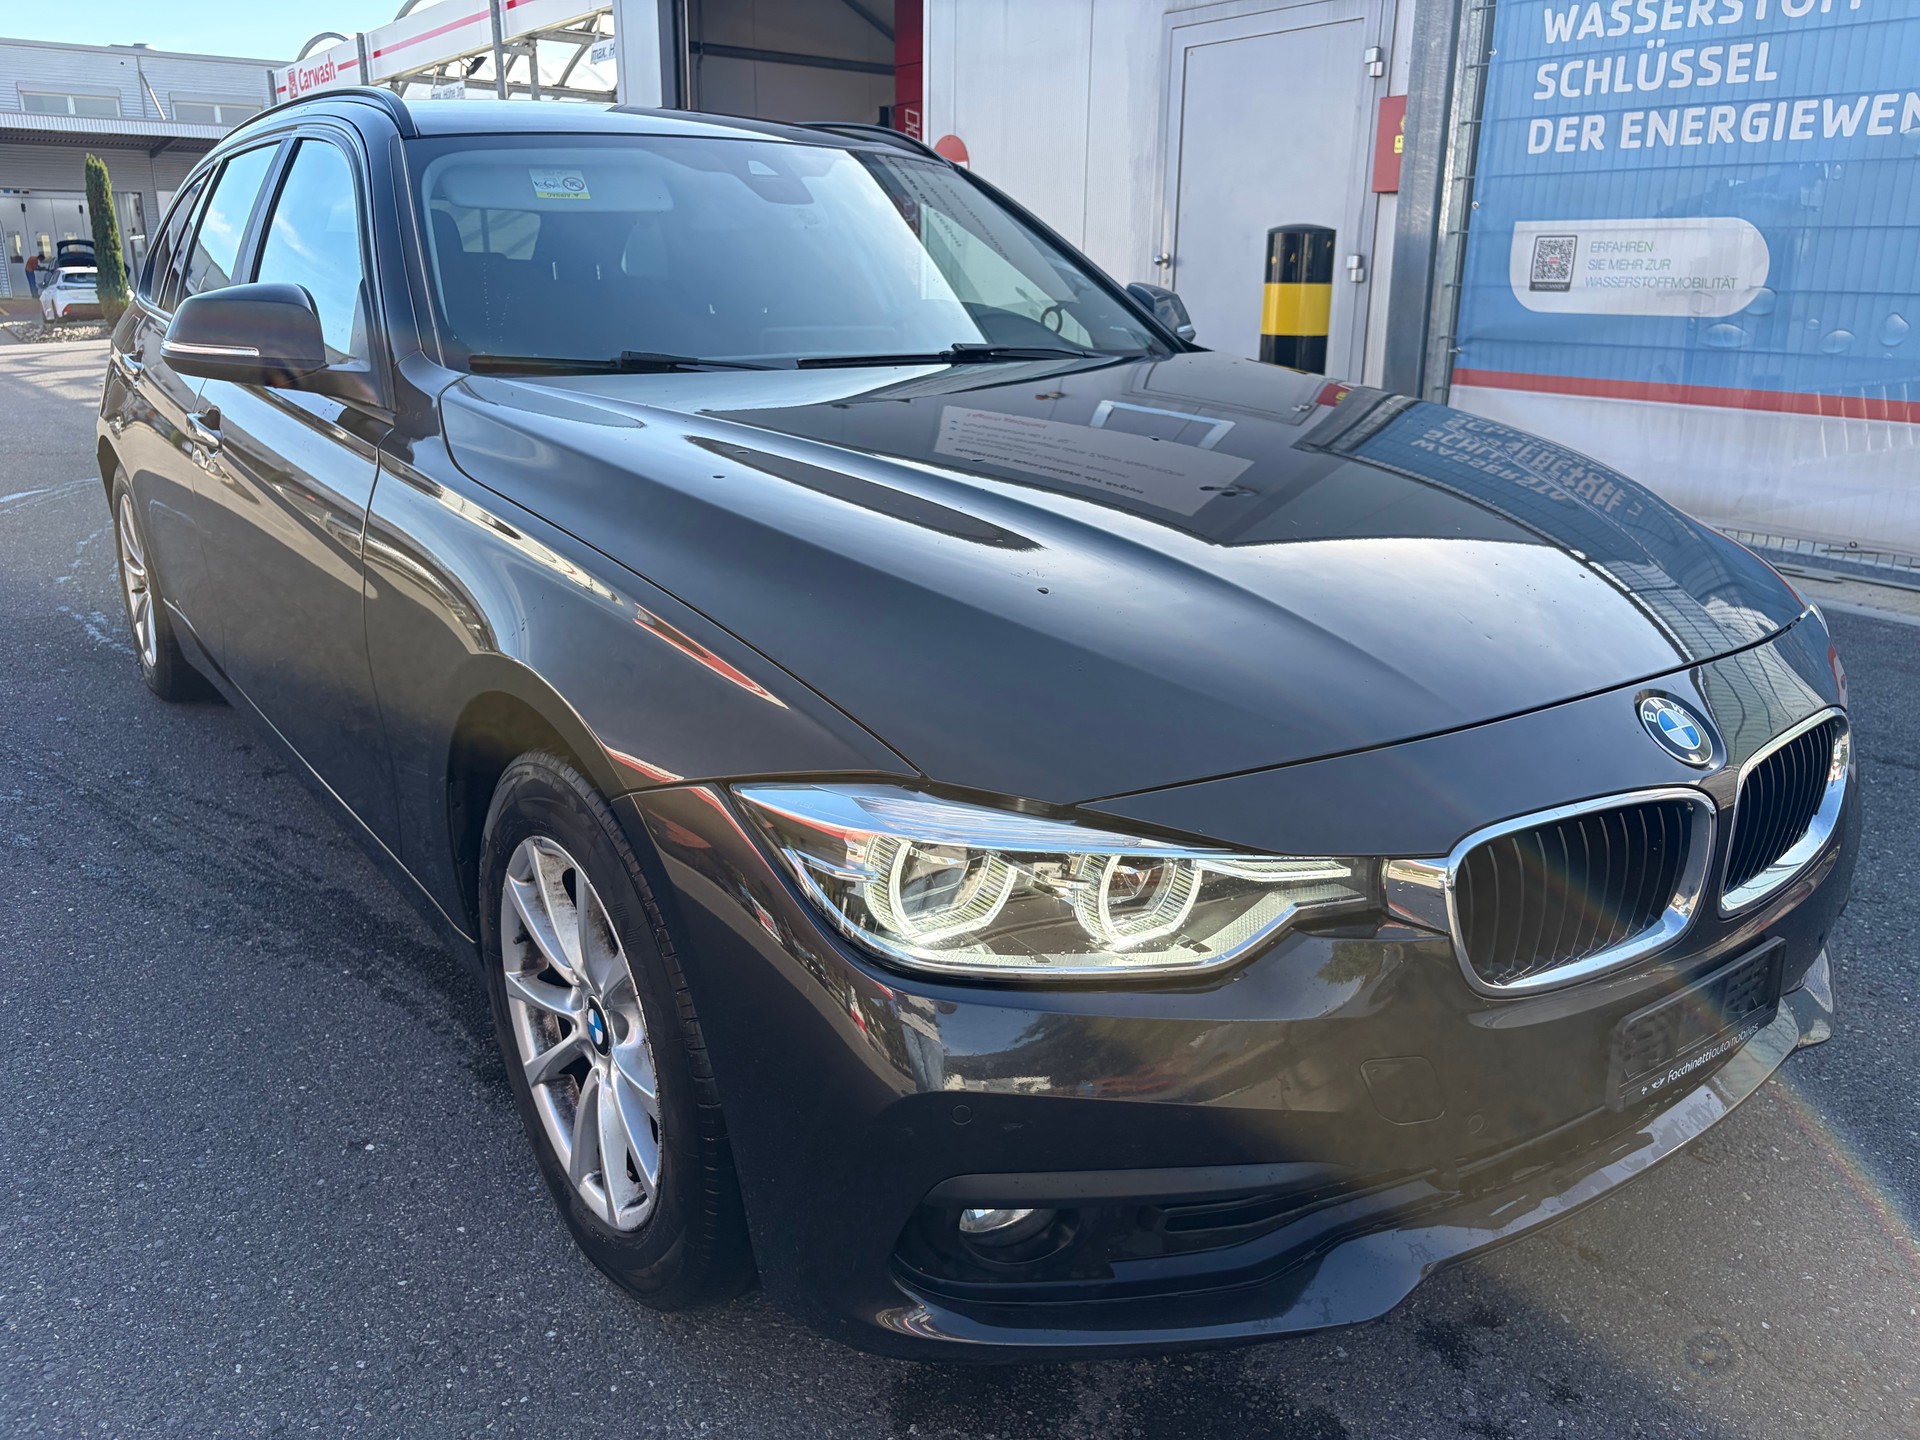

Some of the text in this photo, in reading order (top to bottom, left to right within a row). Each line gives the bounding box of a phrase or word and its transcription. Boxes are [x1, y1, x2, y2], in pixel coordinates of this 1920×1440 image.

[1544, 0, 1862, 44] WASSERS
[298, 53, 336, 92] Carwash
[1533, 39, 1777, 100] SCHLÜSSEL
[1527, 115, 1605, 154] DER
[1590, 241, 1654, 253] ERFAHREN
[1587, 258, 1671, 271] SIE MEHR ZUR
[1584, 274, 1738, 290] WASSERSTOFFMOBILITÄT
[1644, 698, 1684, 723] BMW
